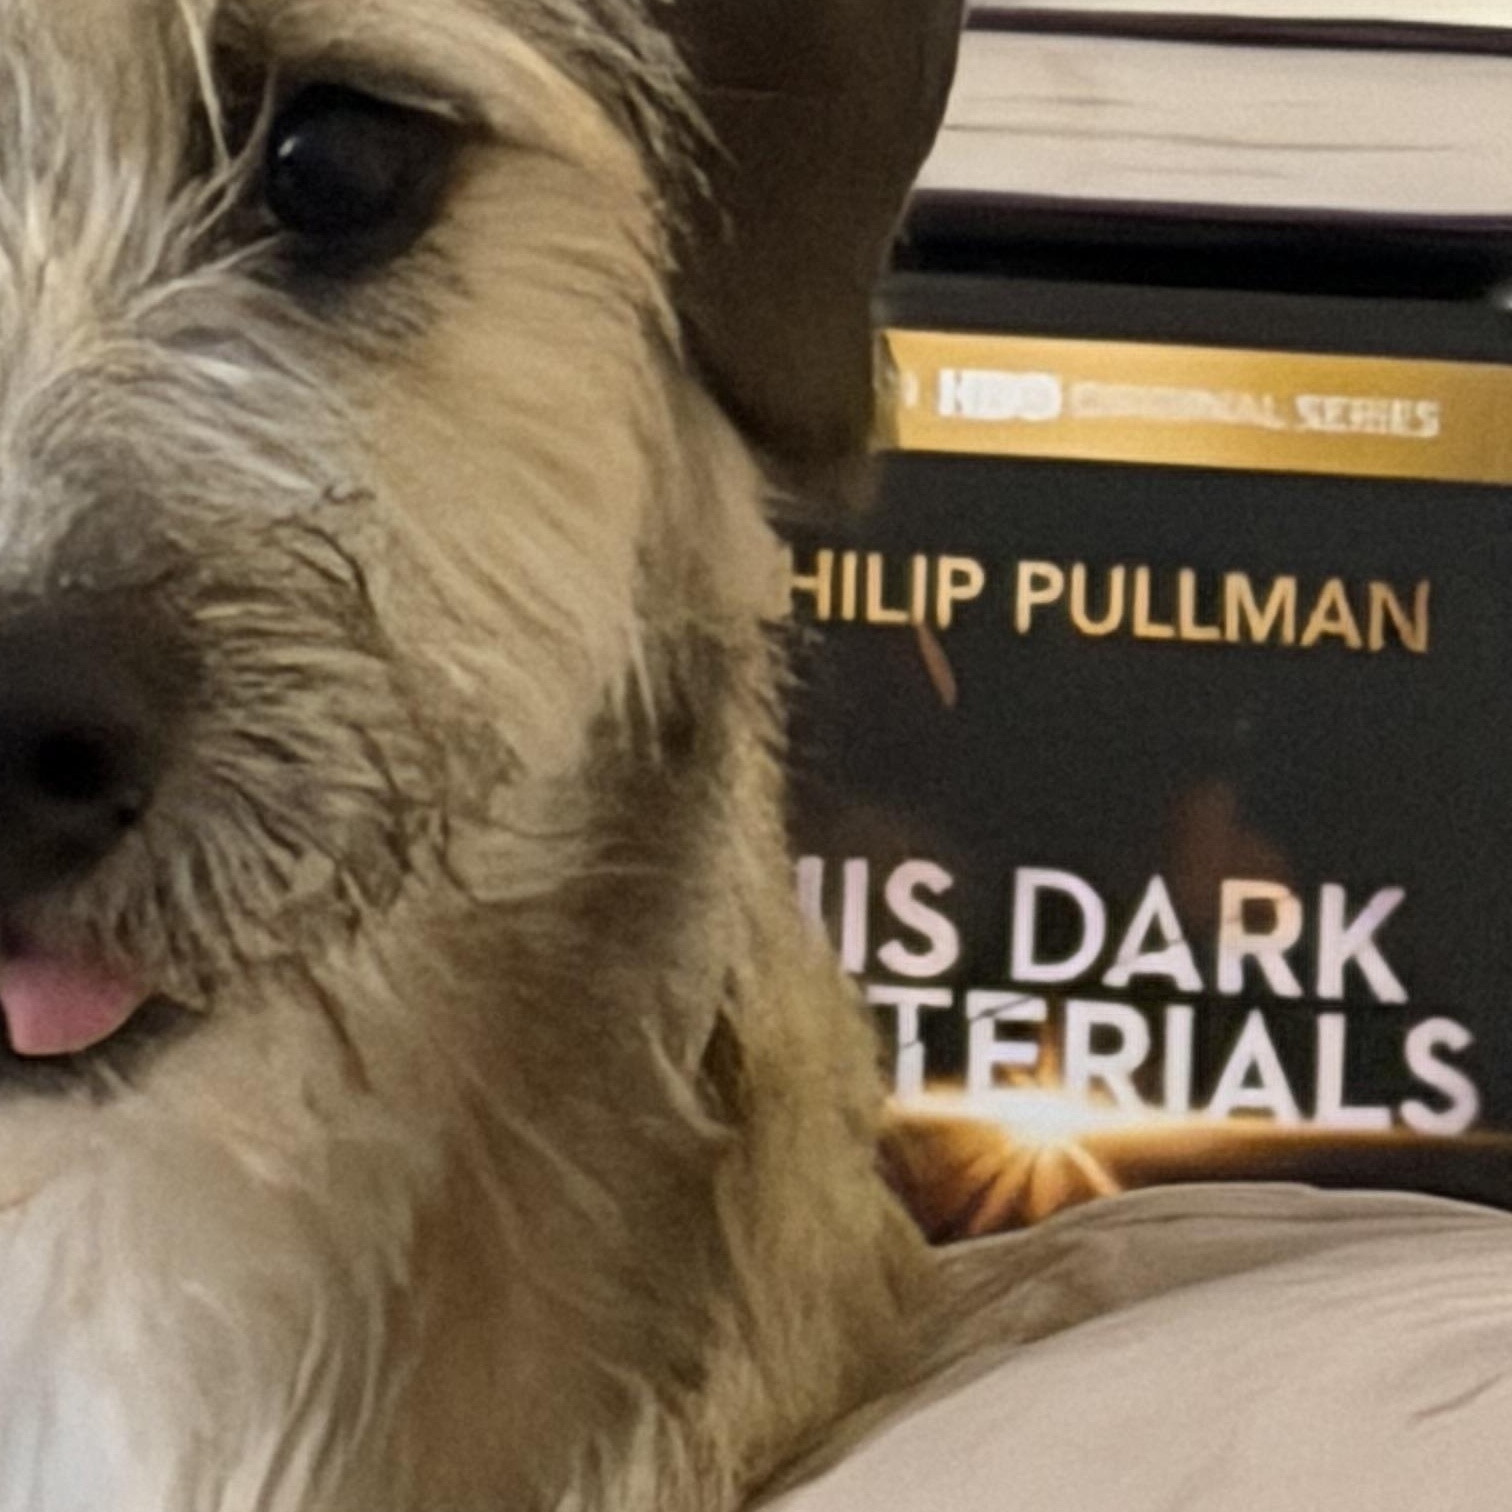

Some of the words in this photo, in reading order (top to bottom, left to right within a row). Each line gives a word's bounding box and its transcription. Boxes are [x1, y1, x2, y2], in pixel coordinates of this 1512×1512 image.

[791, 547, 985, 631] HILIP
[1015, 559, 1430, 654] PULLMAN
[1009, 865, 1408, 1004] DARK
[865, 985, 1481, 1137] TERIALS
